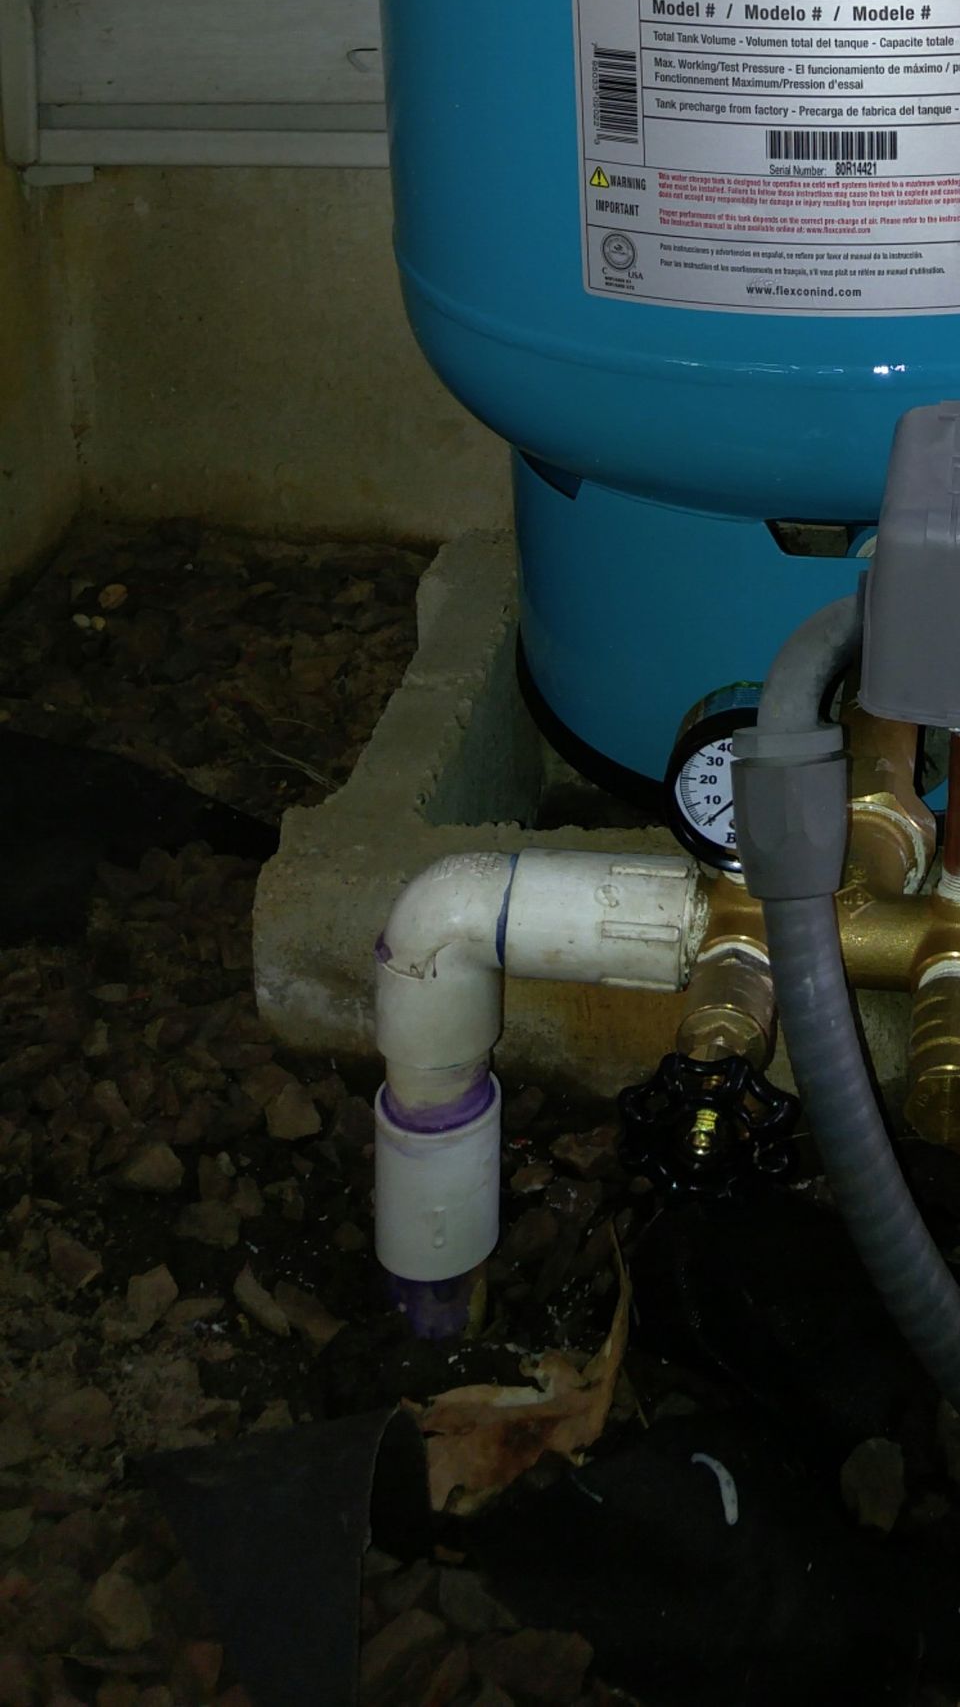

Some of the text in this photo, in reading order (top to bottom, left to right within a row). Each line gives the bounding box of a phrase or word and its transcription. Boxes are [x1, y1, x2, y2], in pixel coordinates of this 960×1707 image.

[652, 0, 700, 17] Model
[705, 3, 716, 18] #
[744, 4, 806, 21] Modelo
[811, 6, 822, 21] #
[852, 6, 915, 21] Modele
[920, 5, 931, 20] #
[653, 30, 675, 42] Total
[676, 32, 699, 44] Tank
[700, 34, 736, 46] Volume
[745, 36, 788, 47] Volumen
[790, 37, 813, 48] total
[815, 37, 831, 48] del
[834, 38, 869, 50] tanque
[879, 37, 923, 49] Capacite
[925, 36, 954, 46] totale
[654, 57, 676, 69] Max.
[677, 58, 740, 73] Working/Test
[742, 63, 785, 74] Pressure
[795, 64, 805, 74] El
[807, 64, 885, 75] funcionamiento
[887, 64, 900, 74] de
[654, 72, 729, 86] Fonctionnement
[731, 77, 826, 89] Maximum/Pression
[655, 98, 677, 110] Tank
[679, 101, 726, 114] precharge
[728, 103, 751, 114] from
[754, 104, 789, 118] factory
[798, 106, 844, 118] Precarga
[846, 106, 859, 116] de
[861, 106, 897, 116] fabrica
[899, 105, 915, 115] del
[917, 104, 951, 117] tanque
[769, 164, 791, 175] Serial
[835, 162, 877, 176] 80R14421
[610, 175, 647, 190] WARNING
[595, 199, 640, 216] IMPORTANT
[746, 286, 862, 297] www.flexconind.com
[706, 757, 724, 766] 30
[699, 775, 718, 784] 20
[703, 795, 721, 804] 10
